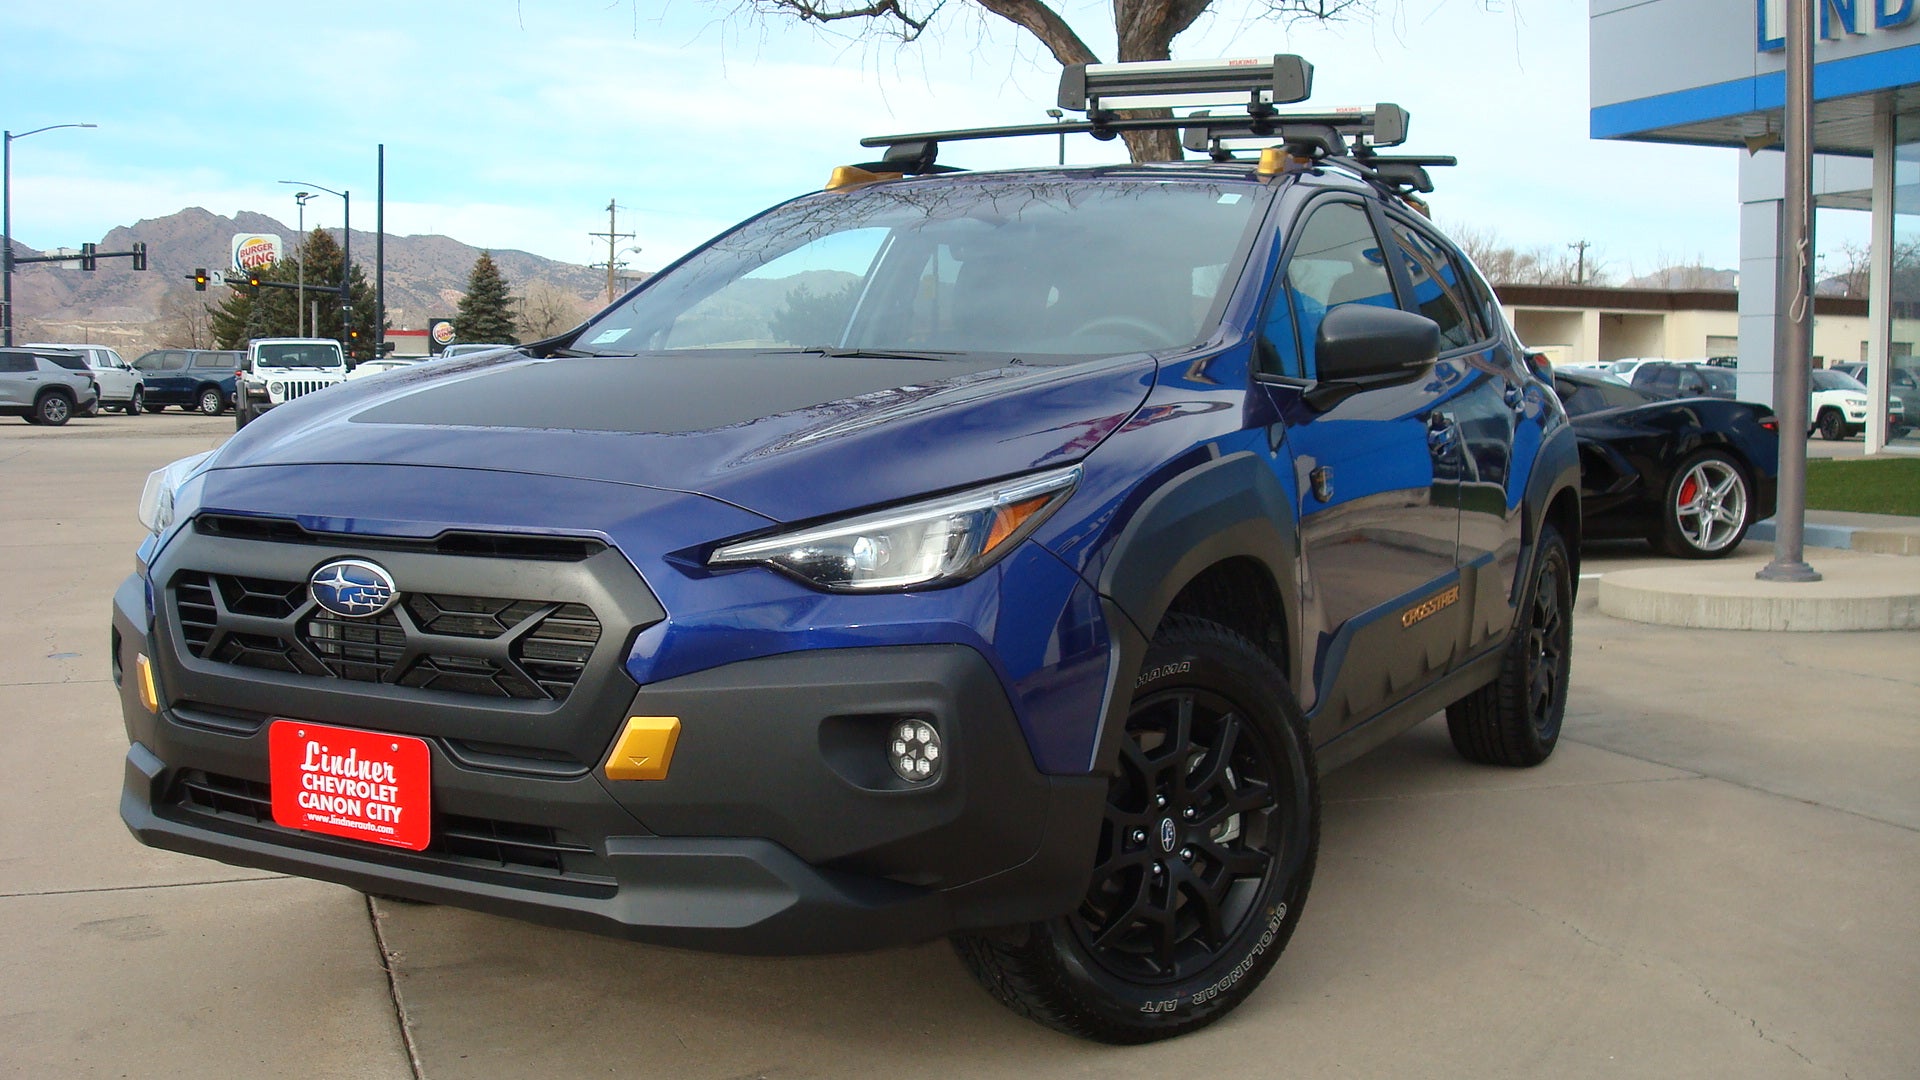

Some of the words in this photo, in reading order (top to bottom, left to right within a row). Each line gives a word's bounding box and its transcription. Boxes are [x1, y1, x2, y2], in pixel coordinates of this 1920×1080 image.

[1757, 0, 1914, 51] LND
[240, 243, 273, 258] BURGER
[242, 251, 275, 270] KING
[1402, 585, 1459, 627] CROSSTREK
[1135, 661, 1191, 689] HAMA
[300, 740, 397, 784] Lindner
[302, 772, 398, 803] CHEVROLET
[298, 791, 361, 817] CANON
[365, 802, 403, 824] CITY
[306, 812, 395, 835] www.lindnerauto.com
[1192, 902, 1288, 1005] GEOLANDAR
[1140, 999, 1178, 1013] A/T
